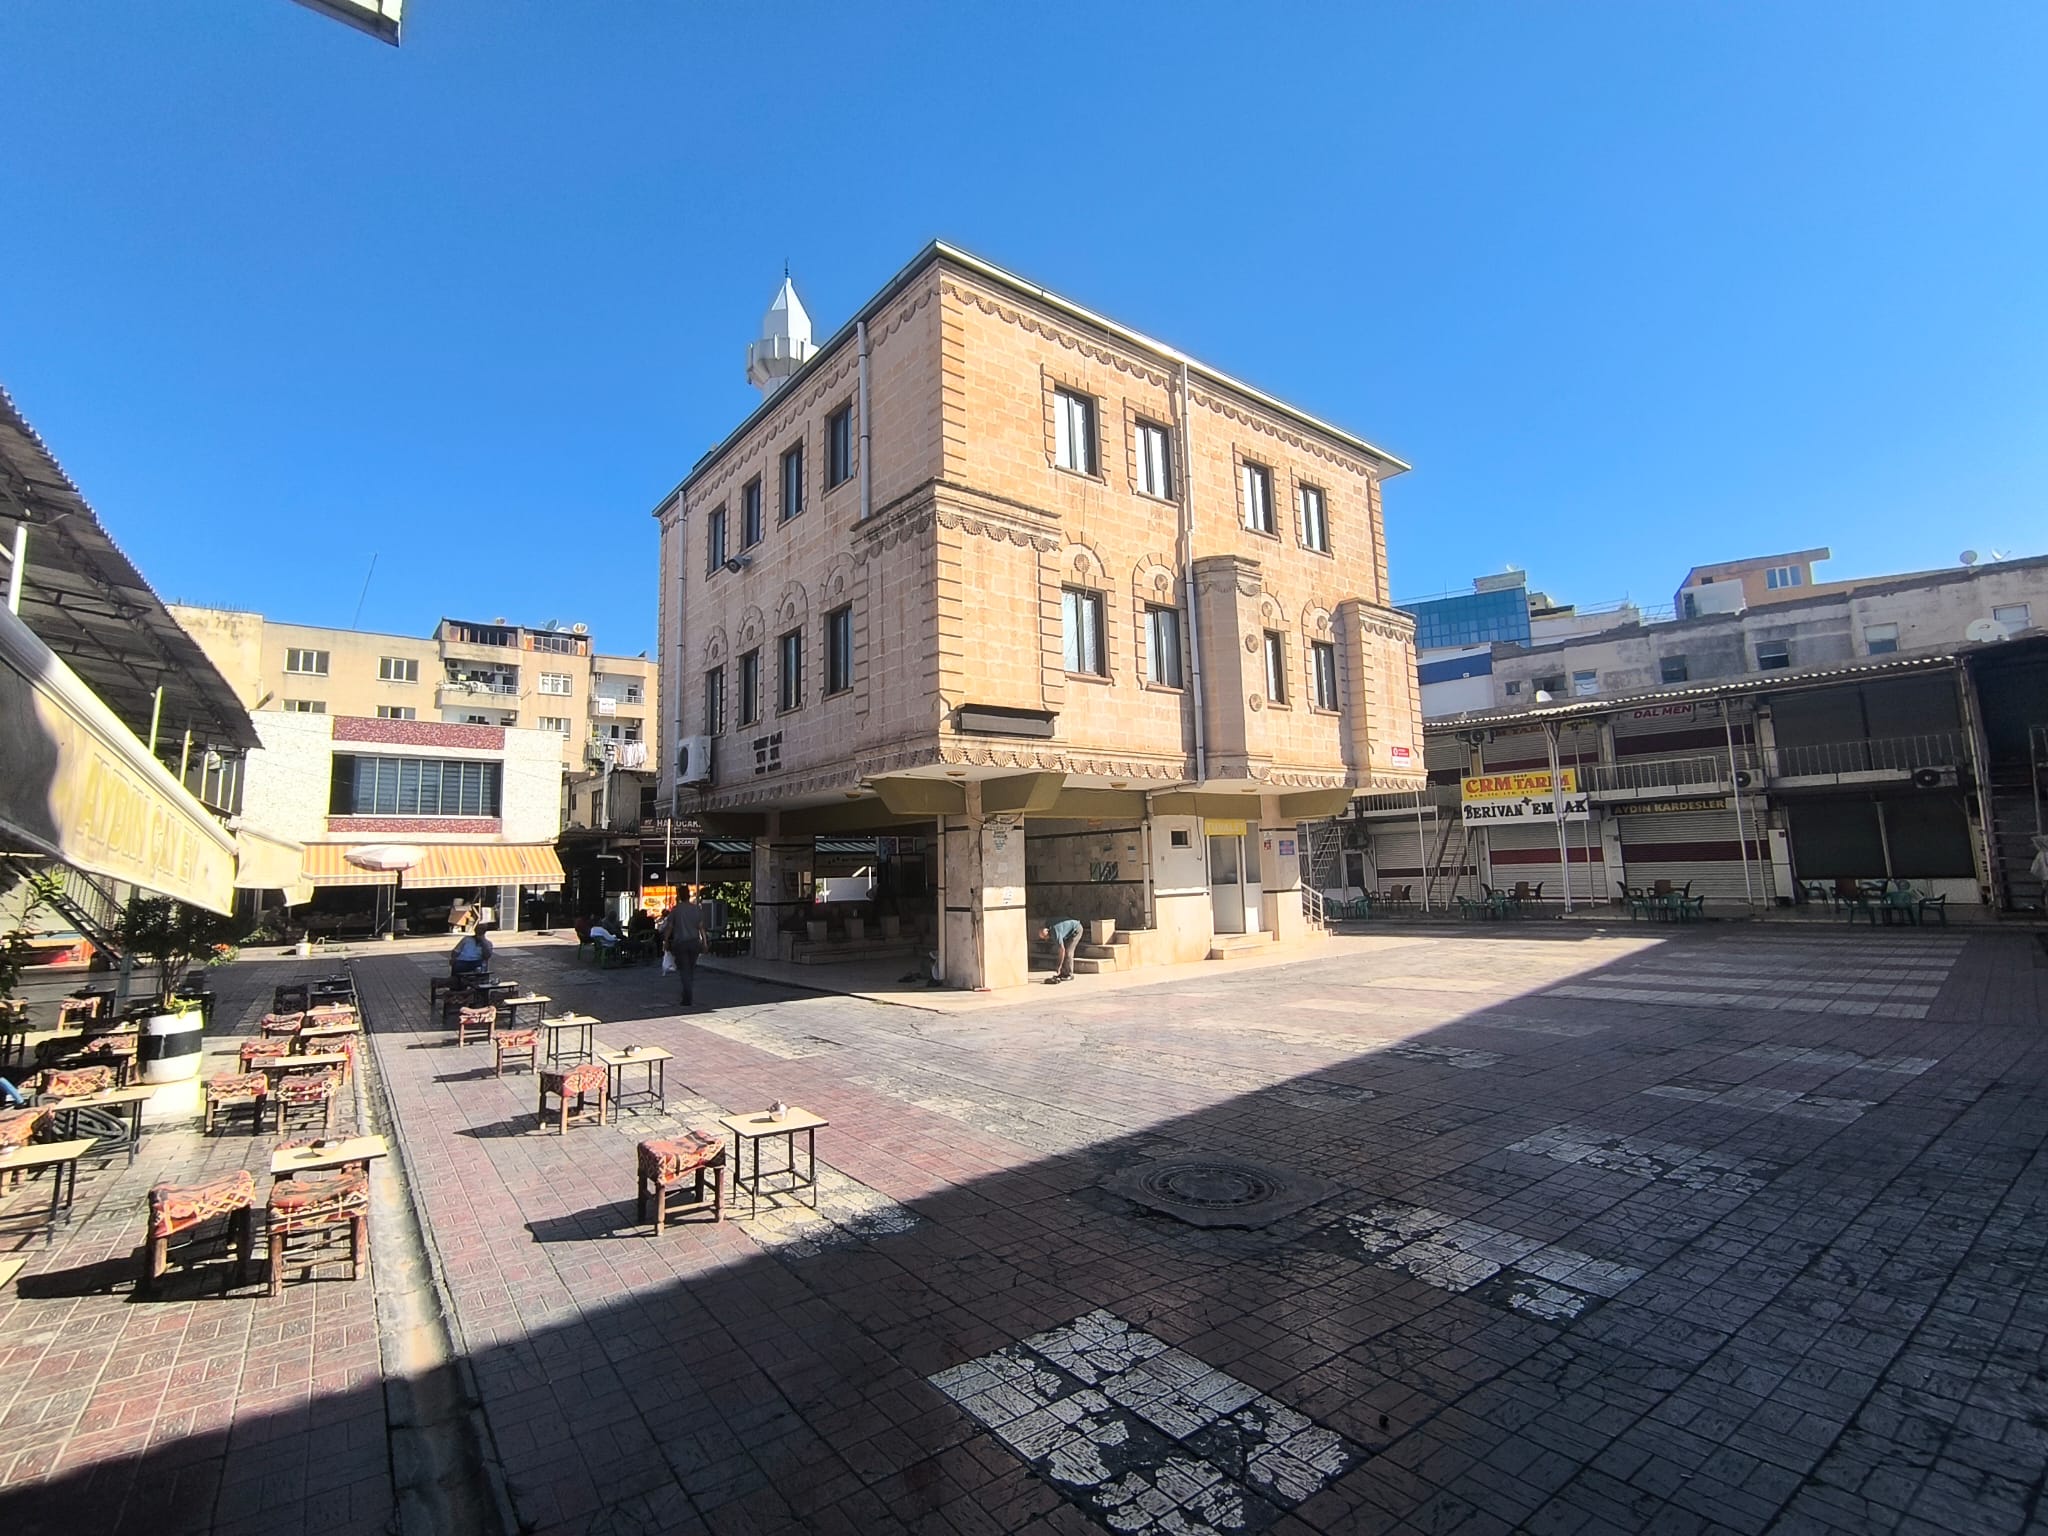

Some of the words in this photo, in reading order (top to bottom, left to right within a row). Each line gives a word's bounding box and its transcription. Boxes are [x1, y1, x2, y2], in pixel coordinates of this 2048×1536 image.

[1466, 776, 1512, 793] CRM
[1464, 802, 1523, 819] BERİVAN
[1531, 798, 1588, 815] EMAK
